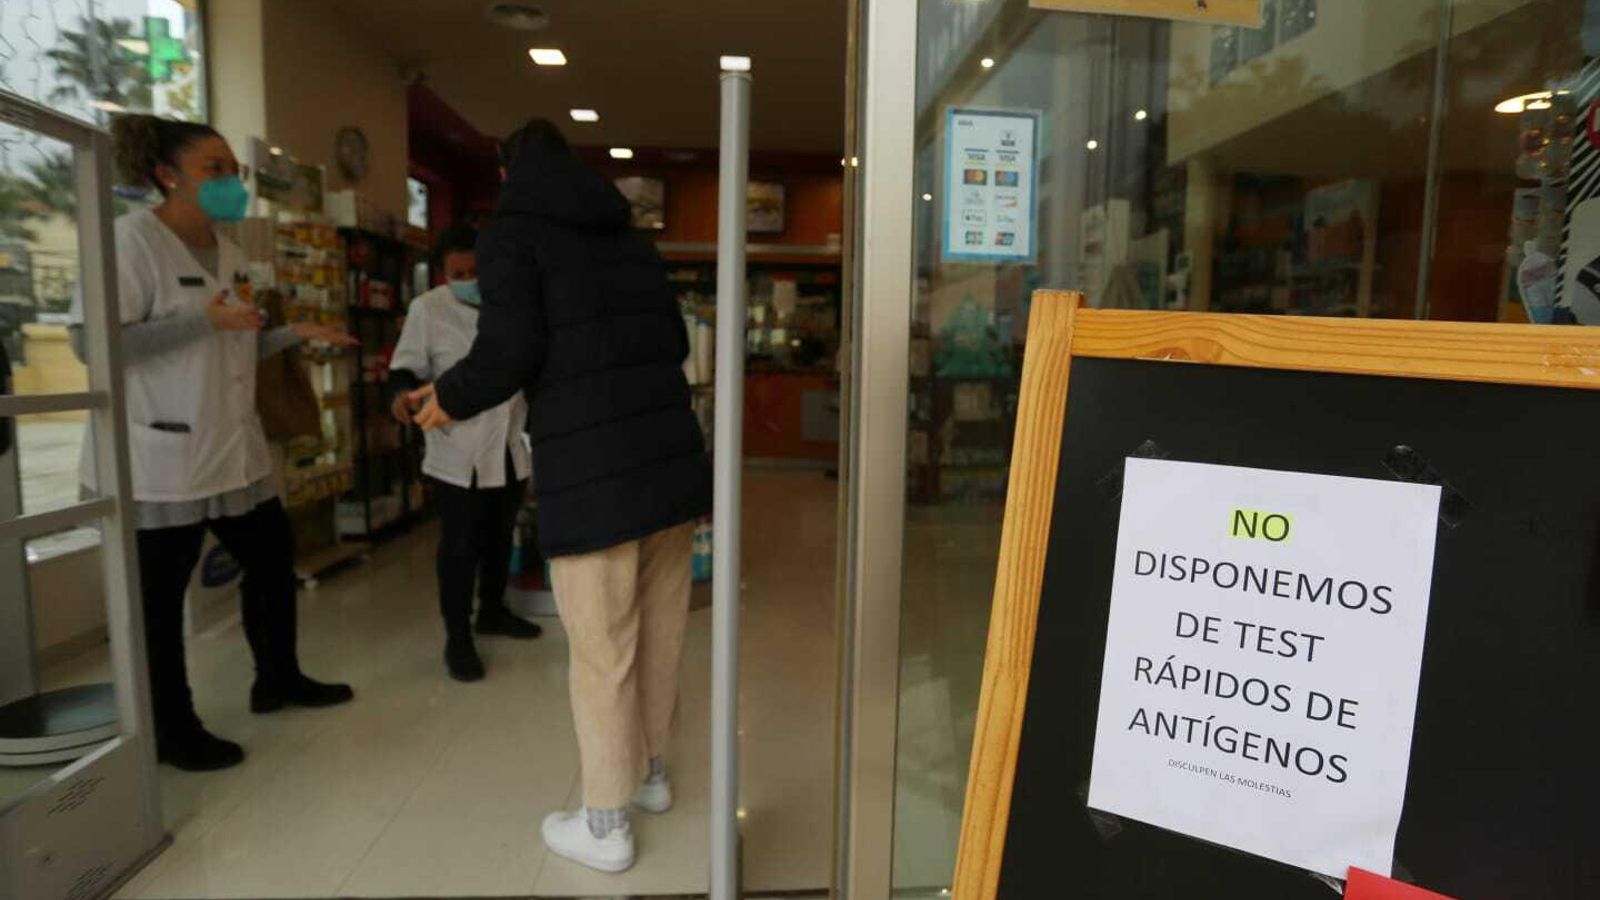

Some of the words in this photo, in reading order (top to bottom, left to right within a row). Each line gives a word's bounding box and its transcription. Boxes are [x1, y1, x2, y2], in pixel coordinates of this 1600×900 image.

[1232, 509, 1291, 543] NO
[1134, 550, 1394, 616] DISPONEMOS
[1175, 611, 1222, 645] DE
[1233, 620, 1326, 663] TEST
[1133, 654, 1292, 714] RÁPIDOS
[1305, 690, 1360, 731] DE
[1127, 707, 1349, 785] ANTÍGENOS
[1168, 758, 1218, 777] DISCULPEN
[1219, 772, 1236, 784] LAS
[1237, 777, 1292, 798] MOLESTIAS
